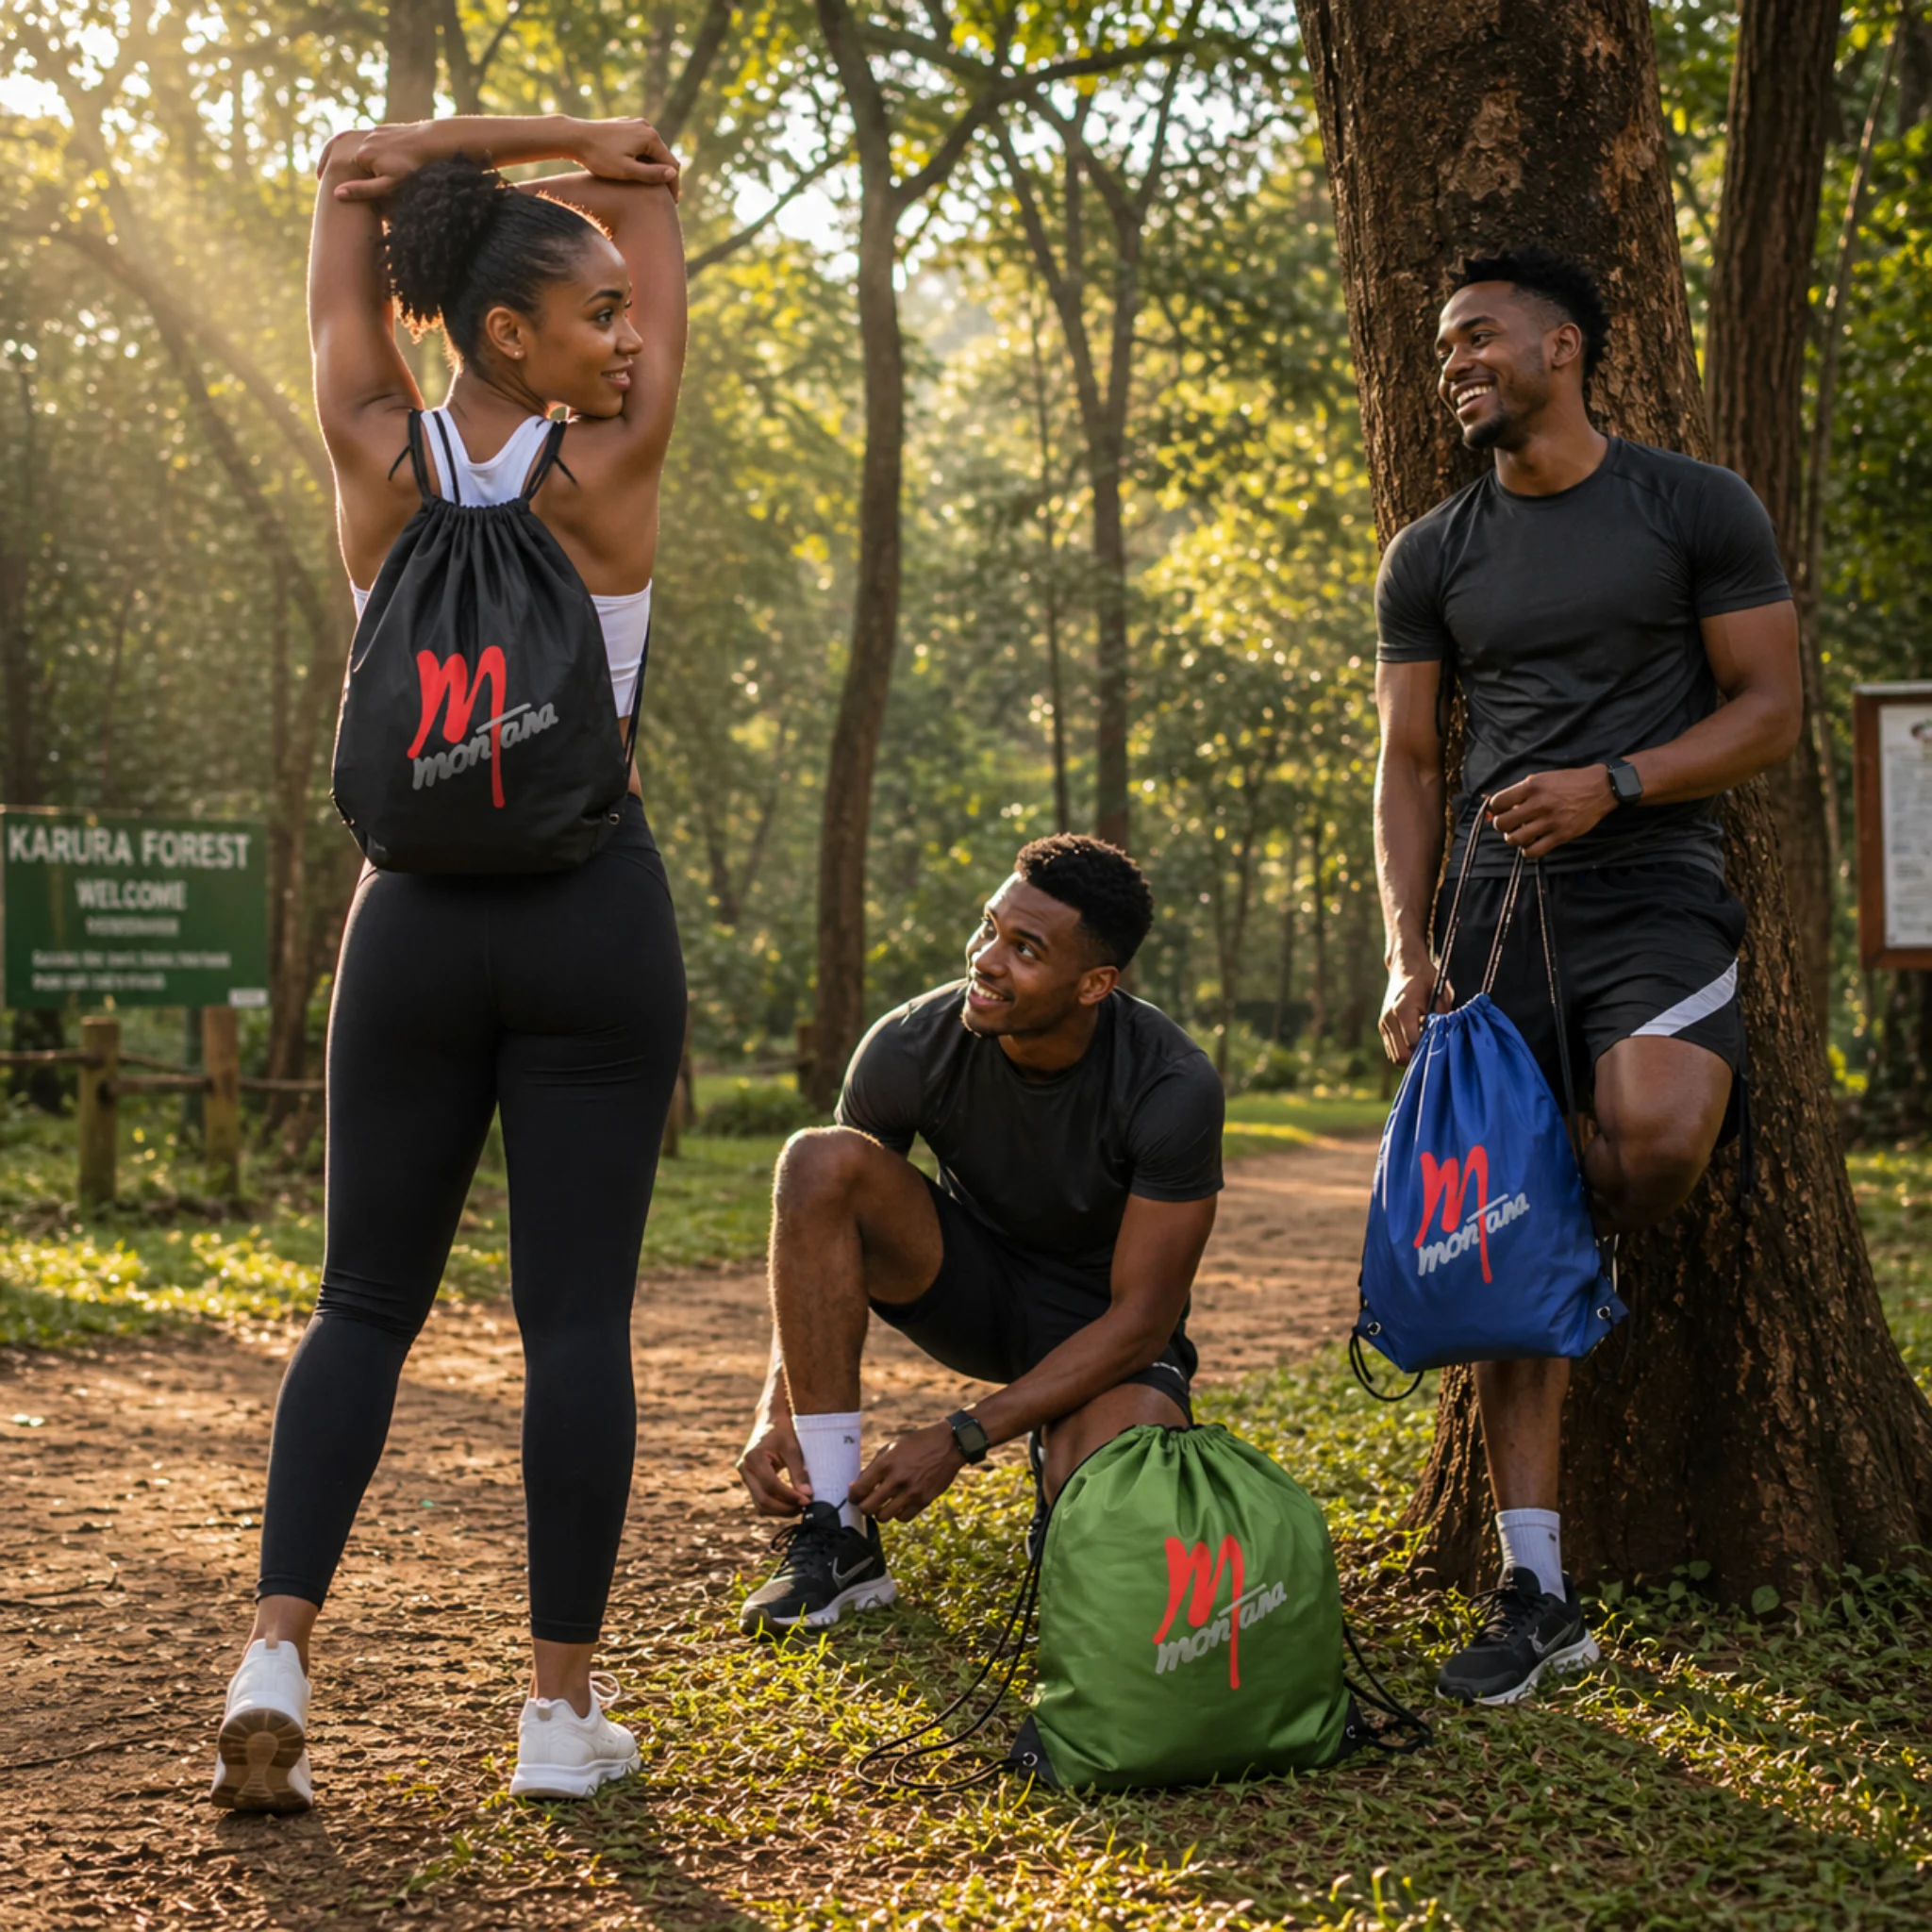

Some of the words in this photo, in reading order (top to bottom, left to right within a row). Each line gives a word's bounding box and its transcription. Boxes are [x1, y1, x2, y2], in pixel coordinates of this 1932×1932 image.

[8, 824, 134, 866] KARURA
[142, 830, 249, 869] FOREST
[75, 878, 187, 910] WELCOME
